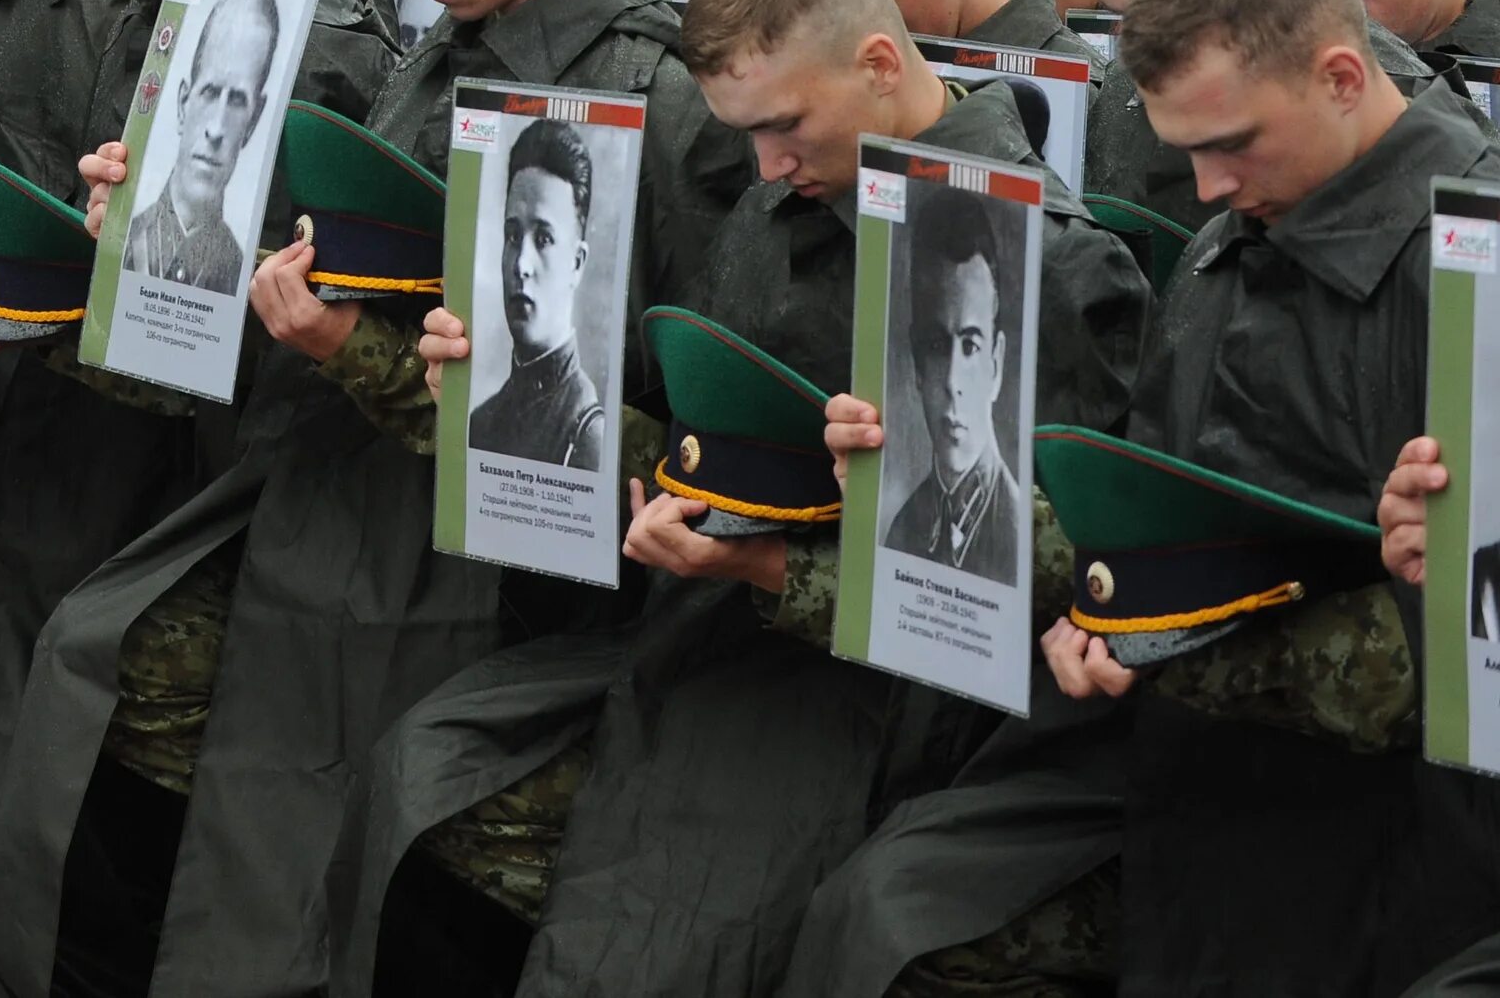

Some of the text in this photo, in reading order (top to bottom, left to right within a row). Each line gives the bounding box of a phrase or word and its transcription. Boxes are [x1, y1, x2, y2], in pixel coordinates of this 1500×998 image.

[995, 52, 1036, 76] ПОМНИТ
[140, 286, 214, 314] Бедин Иван Георгиевич
[479, 462, 595, 494] Бахвалов Петр Александрович
[482, 493, 508, 505] Старший
[895, 568, 999, 612] Байков Степан Васильевич
